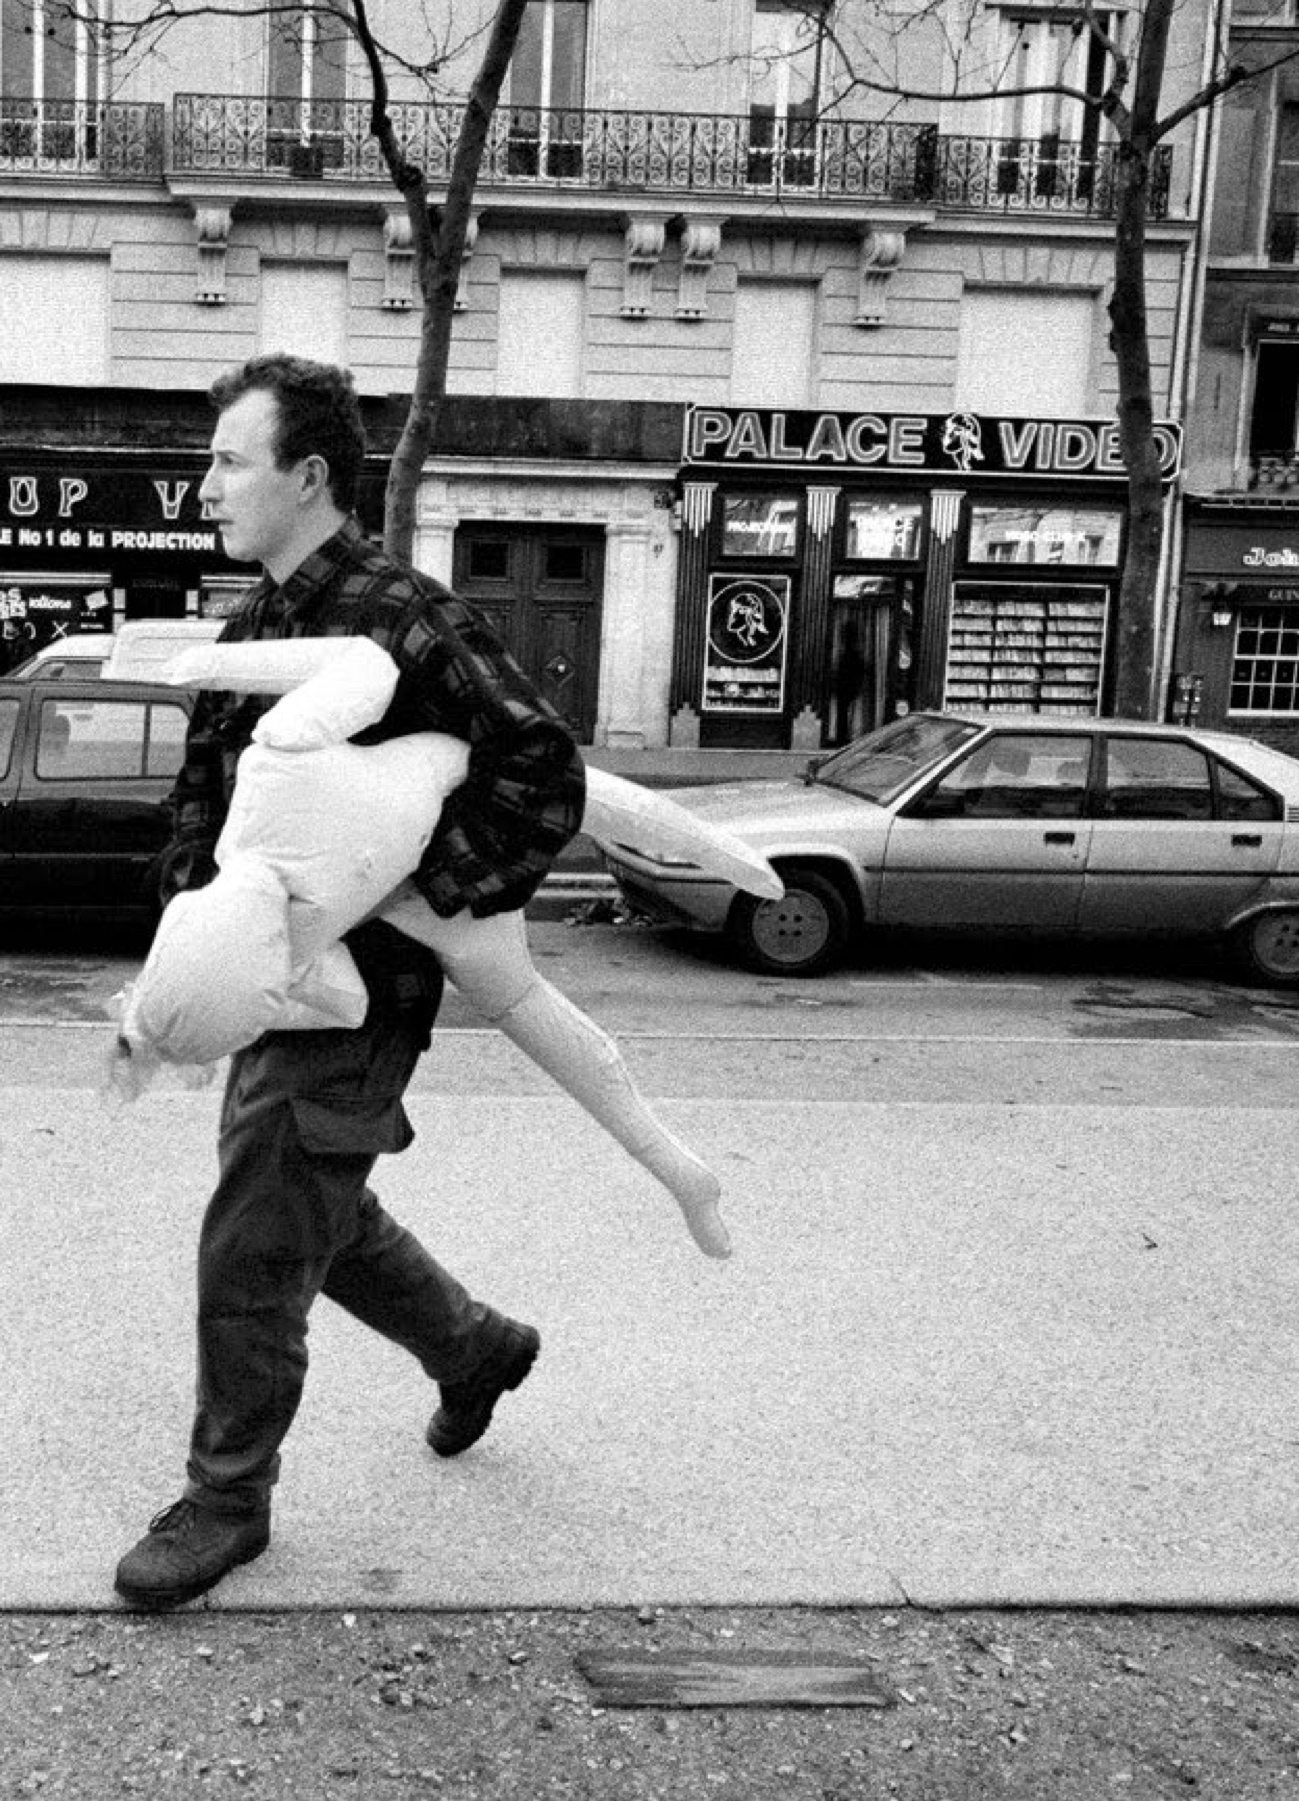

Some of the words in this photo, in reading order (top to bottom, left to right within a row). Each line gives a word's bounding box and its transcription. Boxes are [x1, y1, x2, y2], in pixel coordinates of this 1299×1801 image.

[692, 411, 927, 464] PALACE
[46, 529, 54, 546] 1
[59, 529, 81, 546] de
[87, 529, 105, 548] la
[112, 531, 216, 550] PROJECTION
